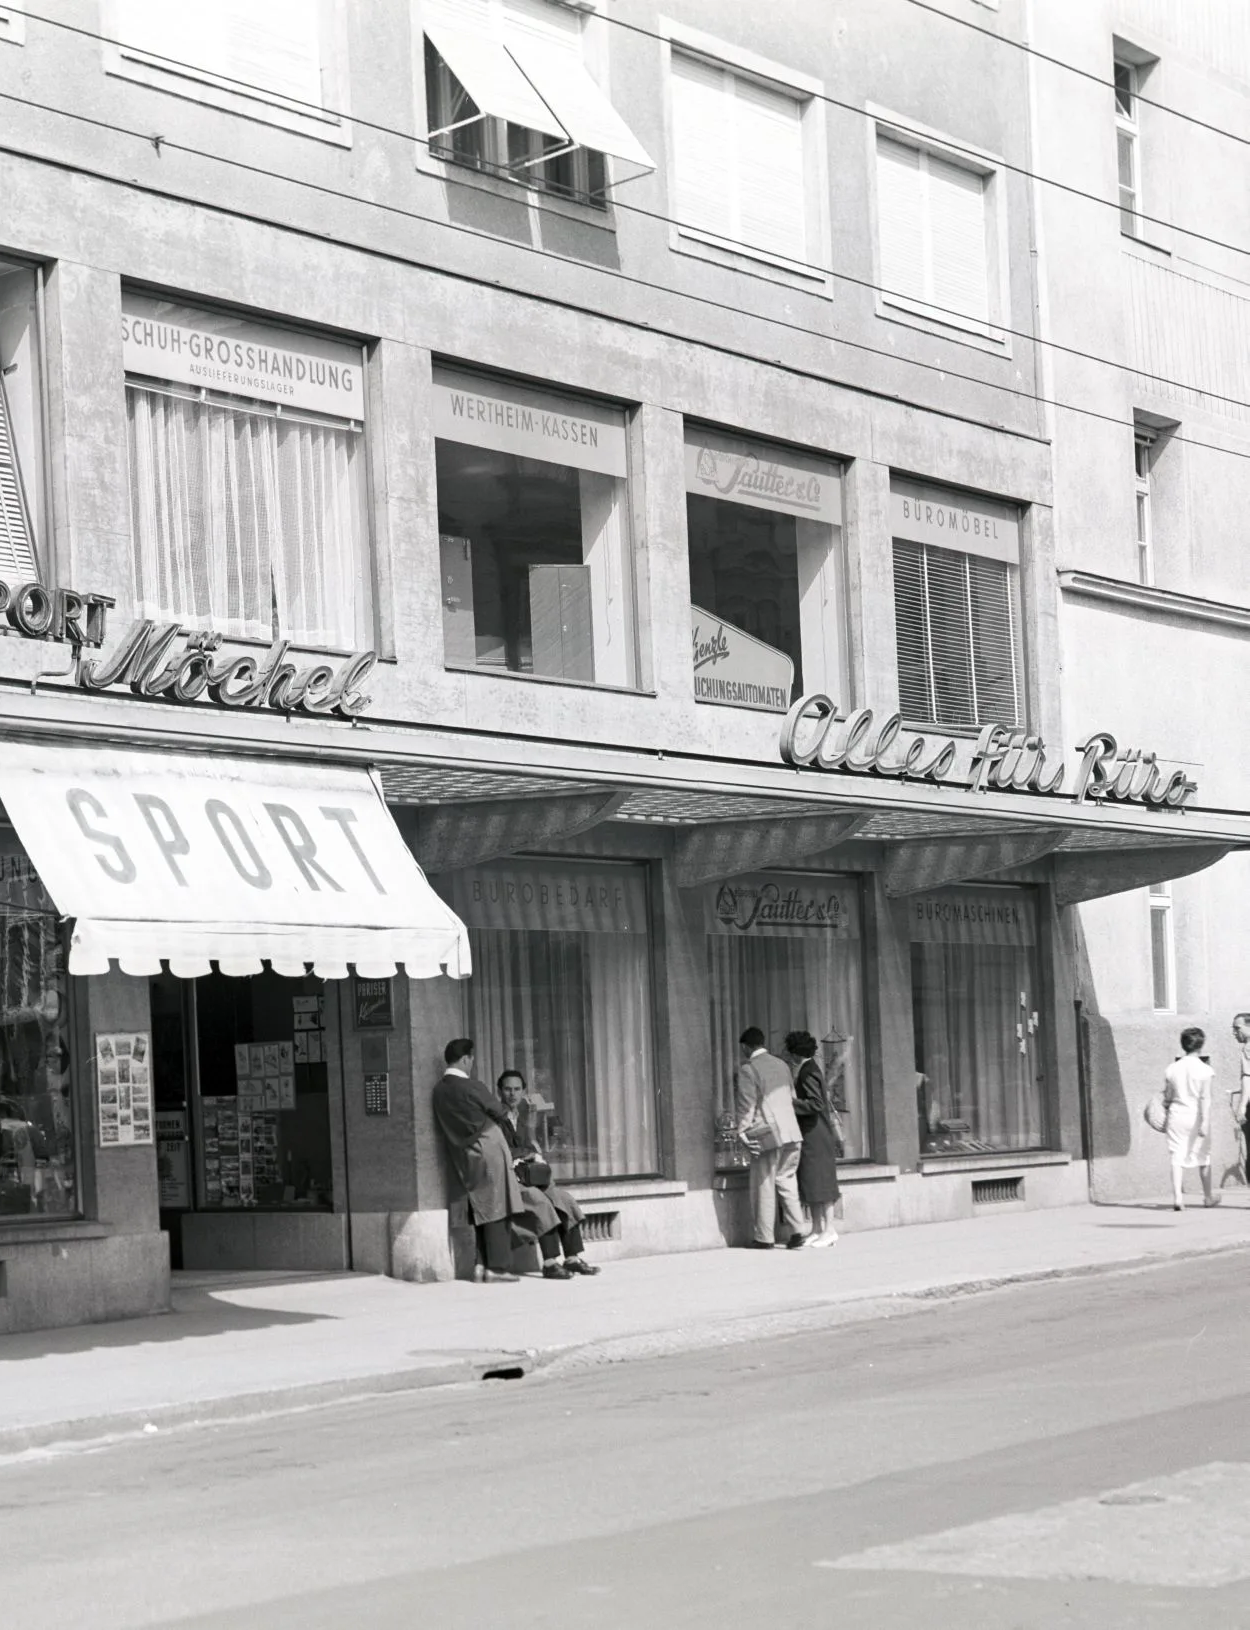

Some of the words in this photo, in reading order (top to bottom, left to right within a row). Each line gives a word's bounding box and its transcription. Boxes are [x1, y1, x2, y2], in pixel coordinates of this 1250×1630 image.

[121, 317, 353, 392] SCHUH-GROSSHANDLUNG
[189, 363, 295, 397] AUSLIEFERUNGSLAGER
[450, 393, 599, 448] WERTHEIM-KASSEN
[903, 497, 999, 540] BÜROMÖBEL
[80, 619, 378, 717] Möchel
[779, 694, 956, 781] Alles
[1072, 732, 1198, 805] Büro
[65, 787, 388, 896] SPORT
[917, 898, 1019, 925] BÜROMASCHINEN
